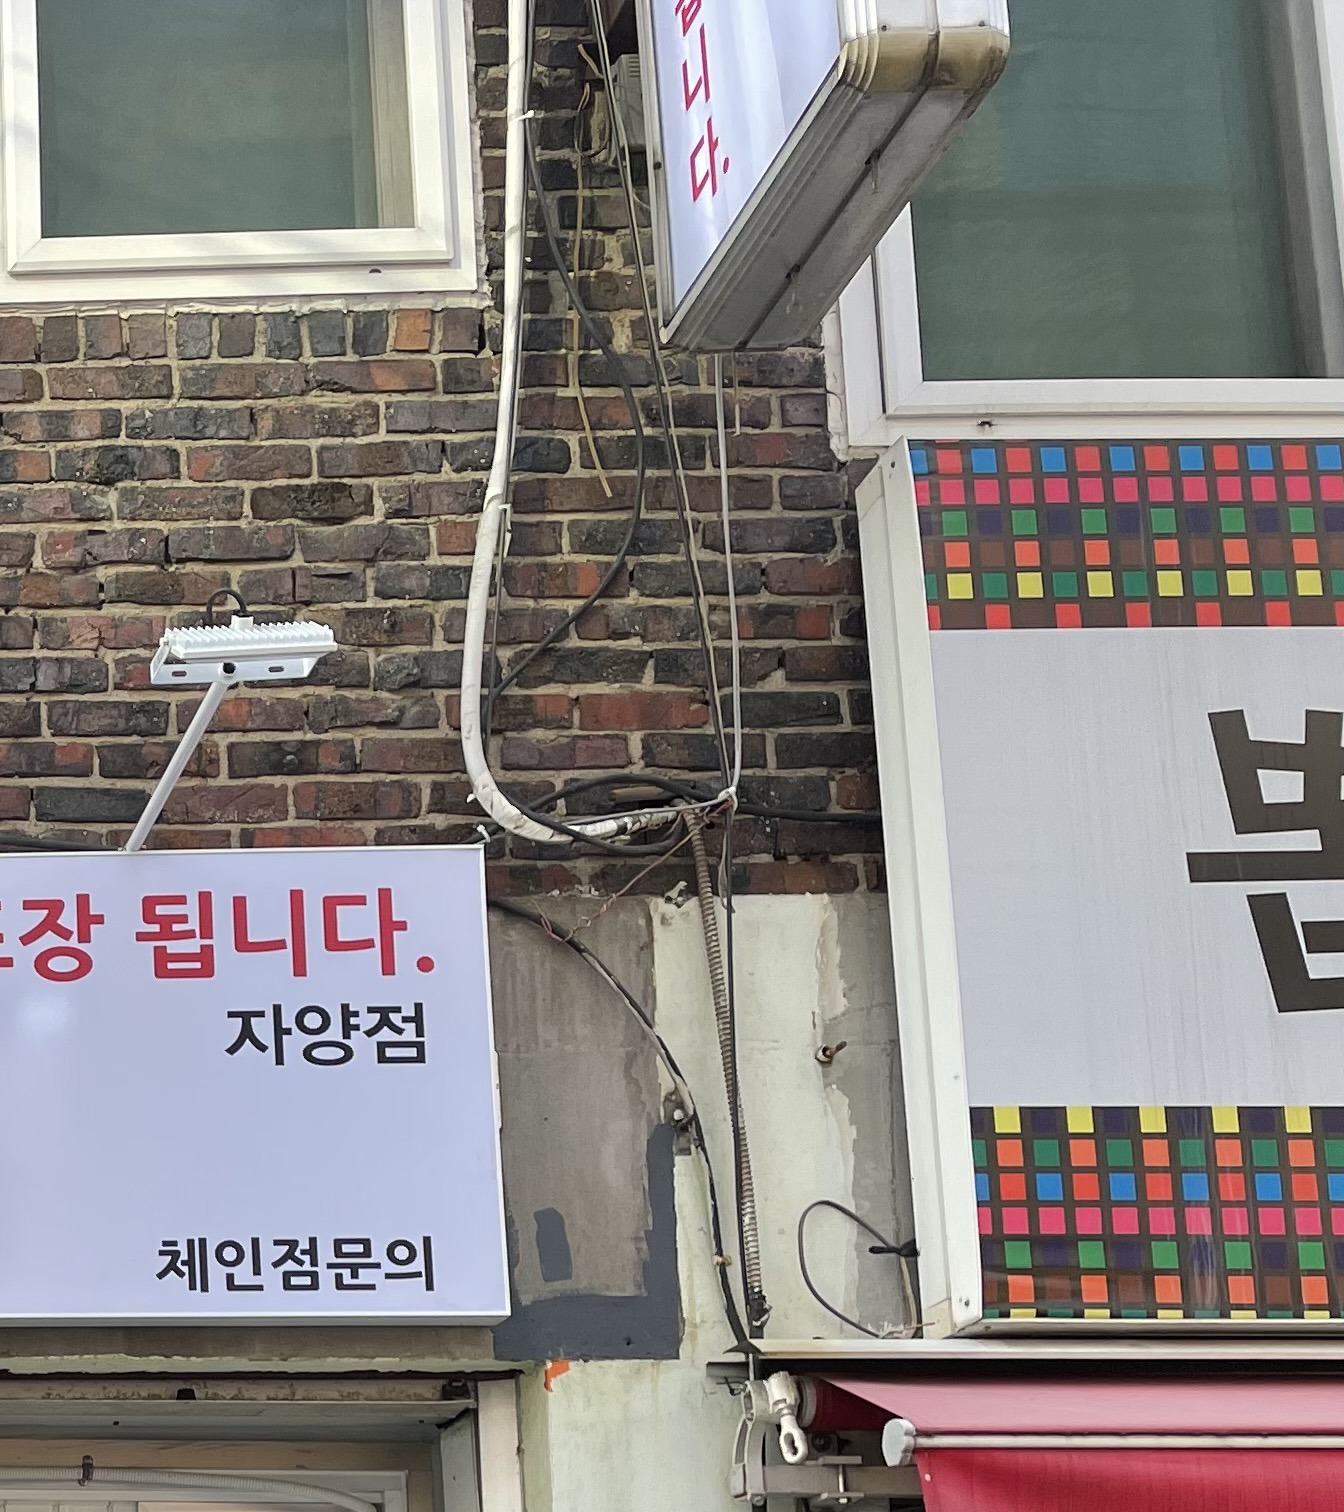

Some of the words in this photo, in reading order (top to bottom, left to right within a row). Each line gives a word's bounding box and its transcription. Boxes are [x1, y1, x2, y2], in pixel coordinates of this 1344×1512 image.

[674, 0, 731, 203] 니다.
[133, 886, 435, 981] 됩니다.
[223, 1001, 429, 1068] 자양점
[154, 1234, 435, 1294] 체인점문의
